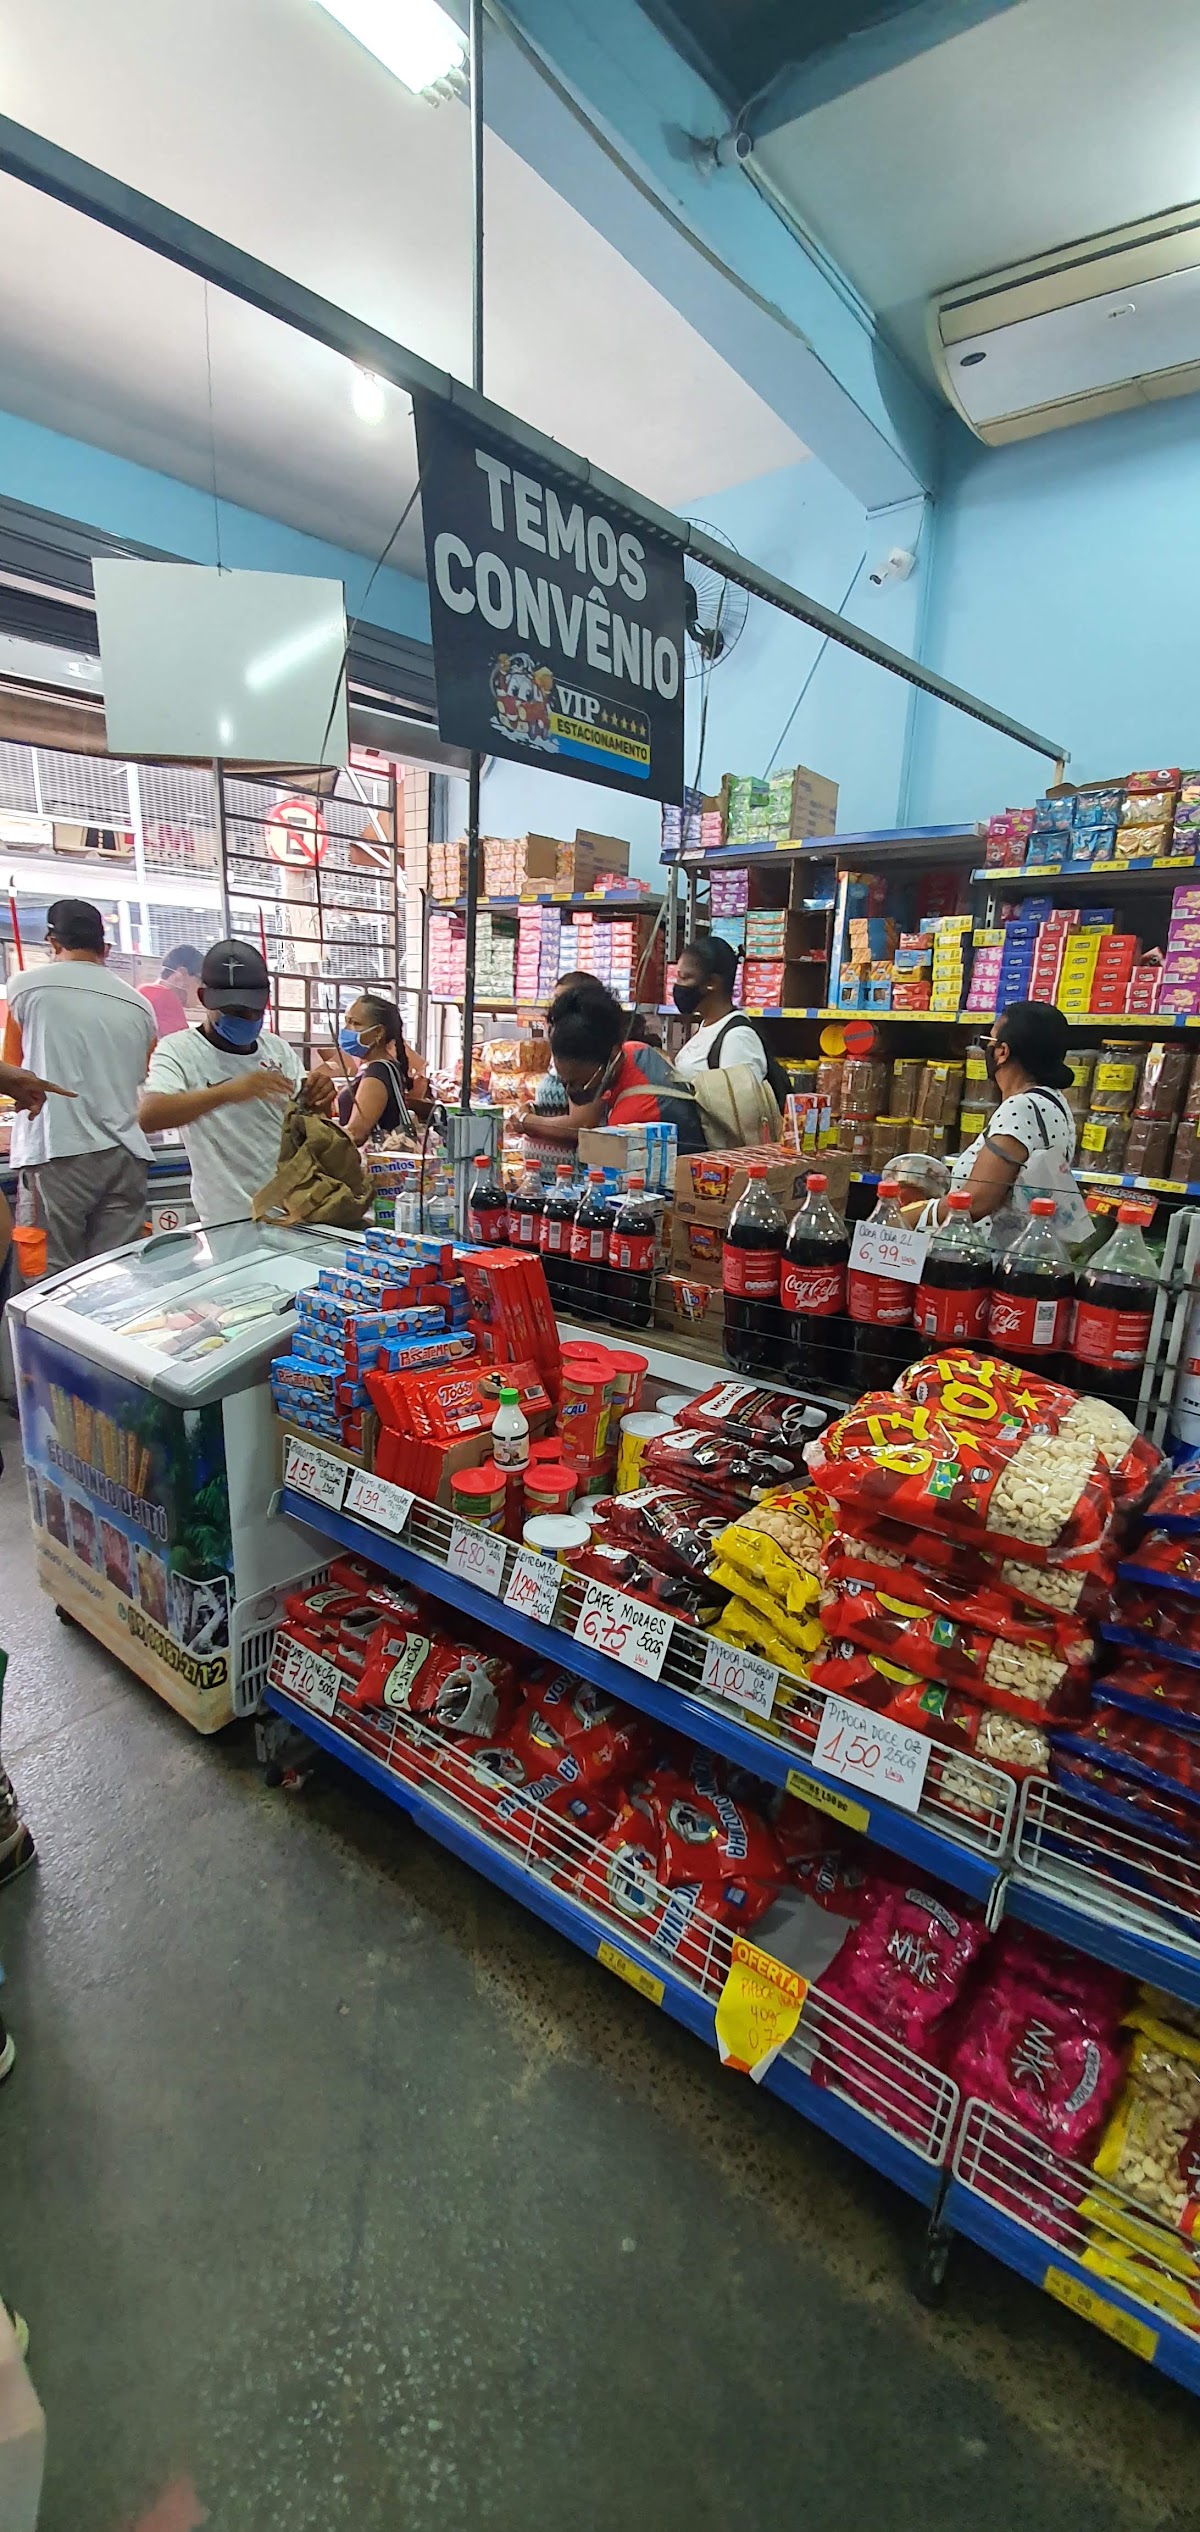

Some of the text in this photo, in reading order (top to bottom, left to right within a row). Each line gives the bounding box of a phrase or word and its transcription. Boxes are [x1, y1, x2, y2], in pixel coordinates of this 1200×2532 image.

[475, 449, 648, 601] TEMOS
[434, 533, 678, 699] CONVÊNIO
[555, 685, 600, 724] VIP
[557, 716, 647, 761] ESTACIONAMENTO
[859, 1242, 899, 1263] 6,99
[900, 1234, 913, 1246] 2L
[785, 1274, 840, 1304] Coca-Cola
[437, 1381, 473, 1406] Toddy
[710, 1384, 745, 1411] MORAES
[454, 1537, 486, 1568] 4,80
[587, 1586, 666, 1635] CAFÉ MORAES
[583, 1610, 633, 1650] 6,75
[637, 1633, 664, 1660] 500G
[391, 1637, 424, 1704] CANECÃO
[710, 1640, 740, 1666] PIPOCA
[707, 1658, 745, 1696] 1,00
[828, 1701, 867, 1734] PIPOCA
[871, 1724, 898, 1745] DOCE
[822, 1726, 881, 1774] 1,50
[884, 1747, 917, 1775] 250G
[737, 1945, 801, 1997] OFERTA
